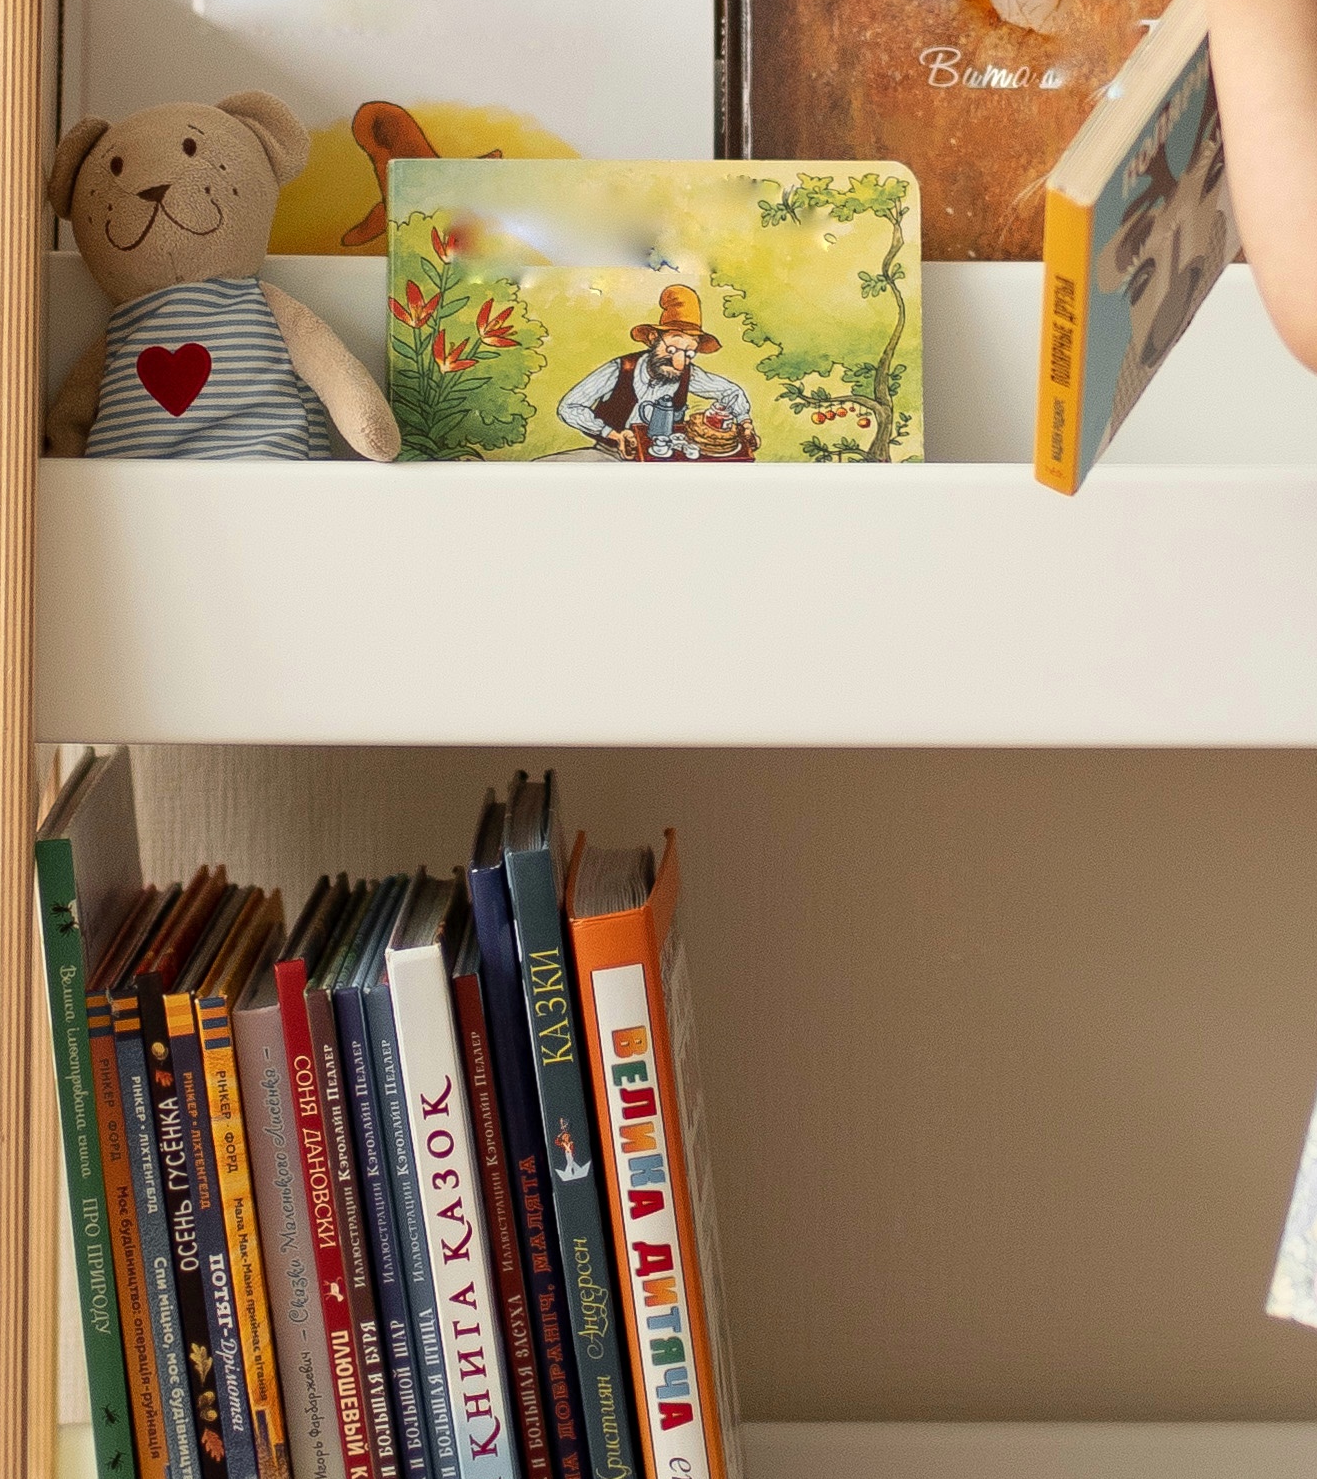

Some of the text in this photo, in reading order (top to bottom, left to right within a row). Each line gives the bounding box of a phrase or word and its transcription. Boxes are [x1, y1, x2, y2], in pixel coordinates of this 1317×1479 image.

[528, 946, 575, 1067] КАЗКИ
[99, 1058, 122, 1162] РІНКЕР ФОРД
[131, 1075, 146, 1122] РІНКЕР
[216, 1070, 239, 1174] РІНКЕР ФОРД
[292, 1055, 337, 1249] СОНЯ ДАНОВСКИ
[610, 1024, 667, 1221] ВЕЛИКА
[82, 1198, 101, 1237] ПРО
[158, 1096, 199, 1272] ОСЕНЬ ГУСЁНКА
[233, 1197, 245, 1233] Мала
[420, 1074, 473, 1266] КАЗОК
[518, 1155, 552, 1274] МАЛЯТА
[86, 1244, 111, 1335] ПРИРОДУ
[117, 1185, 128, 1214] Моє
[133, 1317, 161, 1460] операція-руйнація
[153, 1255, 168, 1289] Спи
[156, 1292, 174, 1349] міцно,
[264, 1066, 328, 1479] Игорь Фарбаржевич Сказки Маленького Лисёнка
[573, 1236, 609, 1360] Андерсен
[167, 1352, 181, 1384] моє
[330, 1329, 369, 1456] ПЛЮШЕВЫЙ
[449, 1281, 501, 1460] КНИГА
[632, 1241, 694, 1432] ДИТЯЧА
